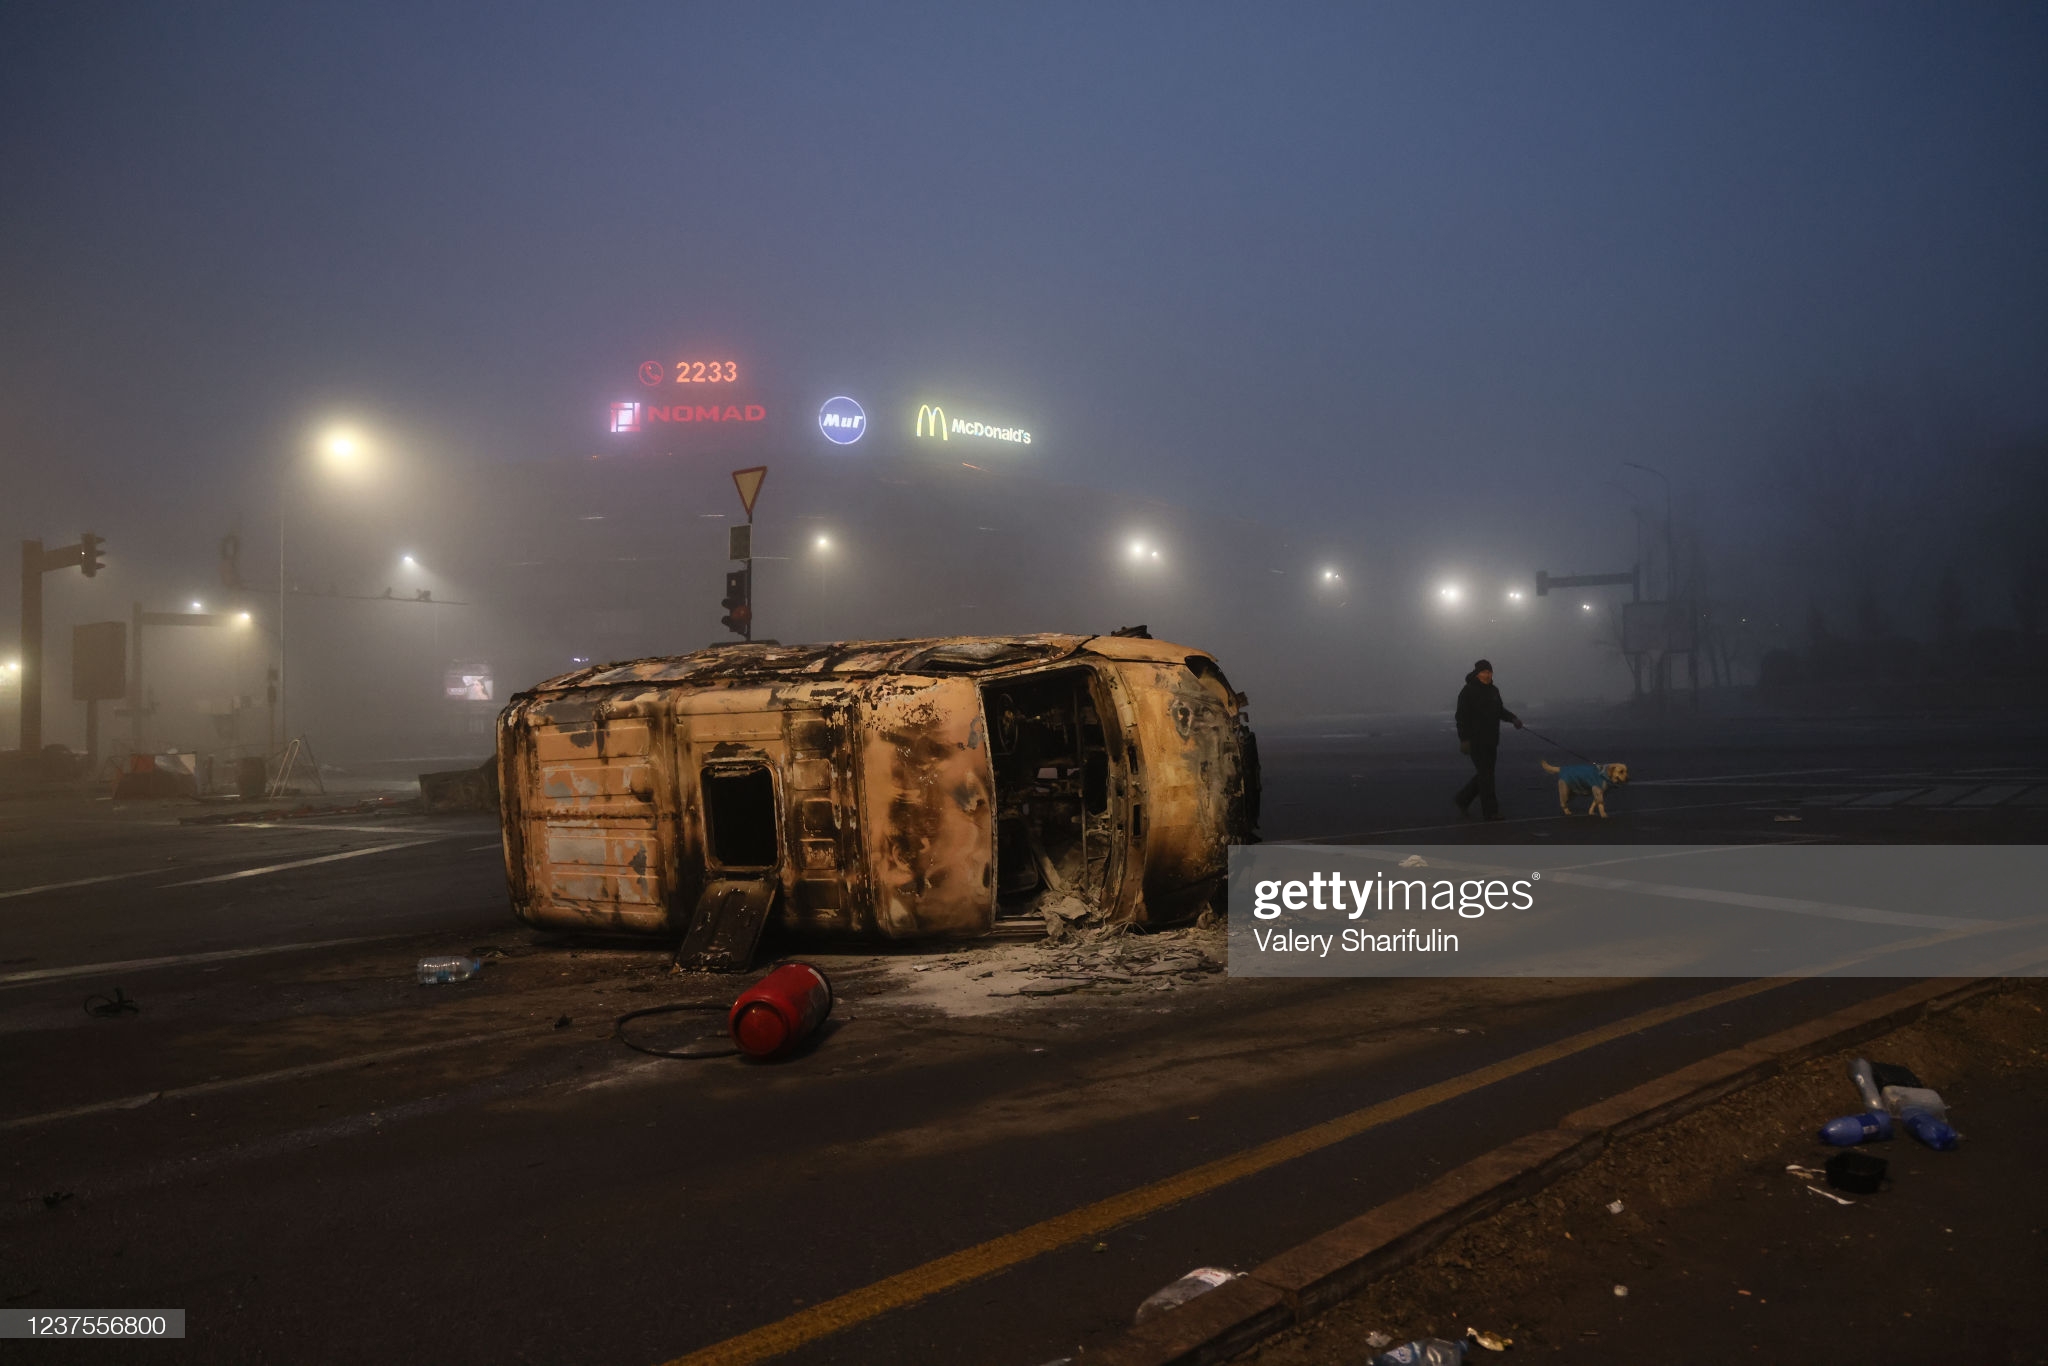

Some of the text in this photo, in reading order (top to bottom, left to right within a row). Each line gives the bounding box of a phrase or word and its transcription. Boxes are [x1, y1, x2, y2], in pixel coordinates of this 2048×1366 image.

[676, 361, 737, 383] 2233
[647, 404, 767, 422] NOMAD
[952, 418, 1031, 444] McDonald's
